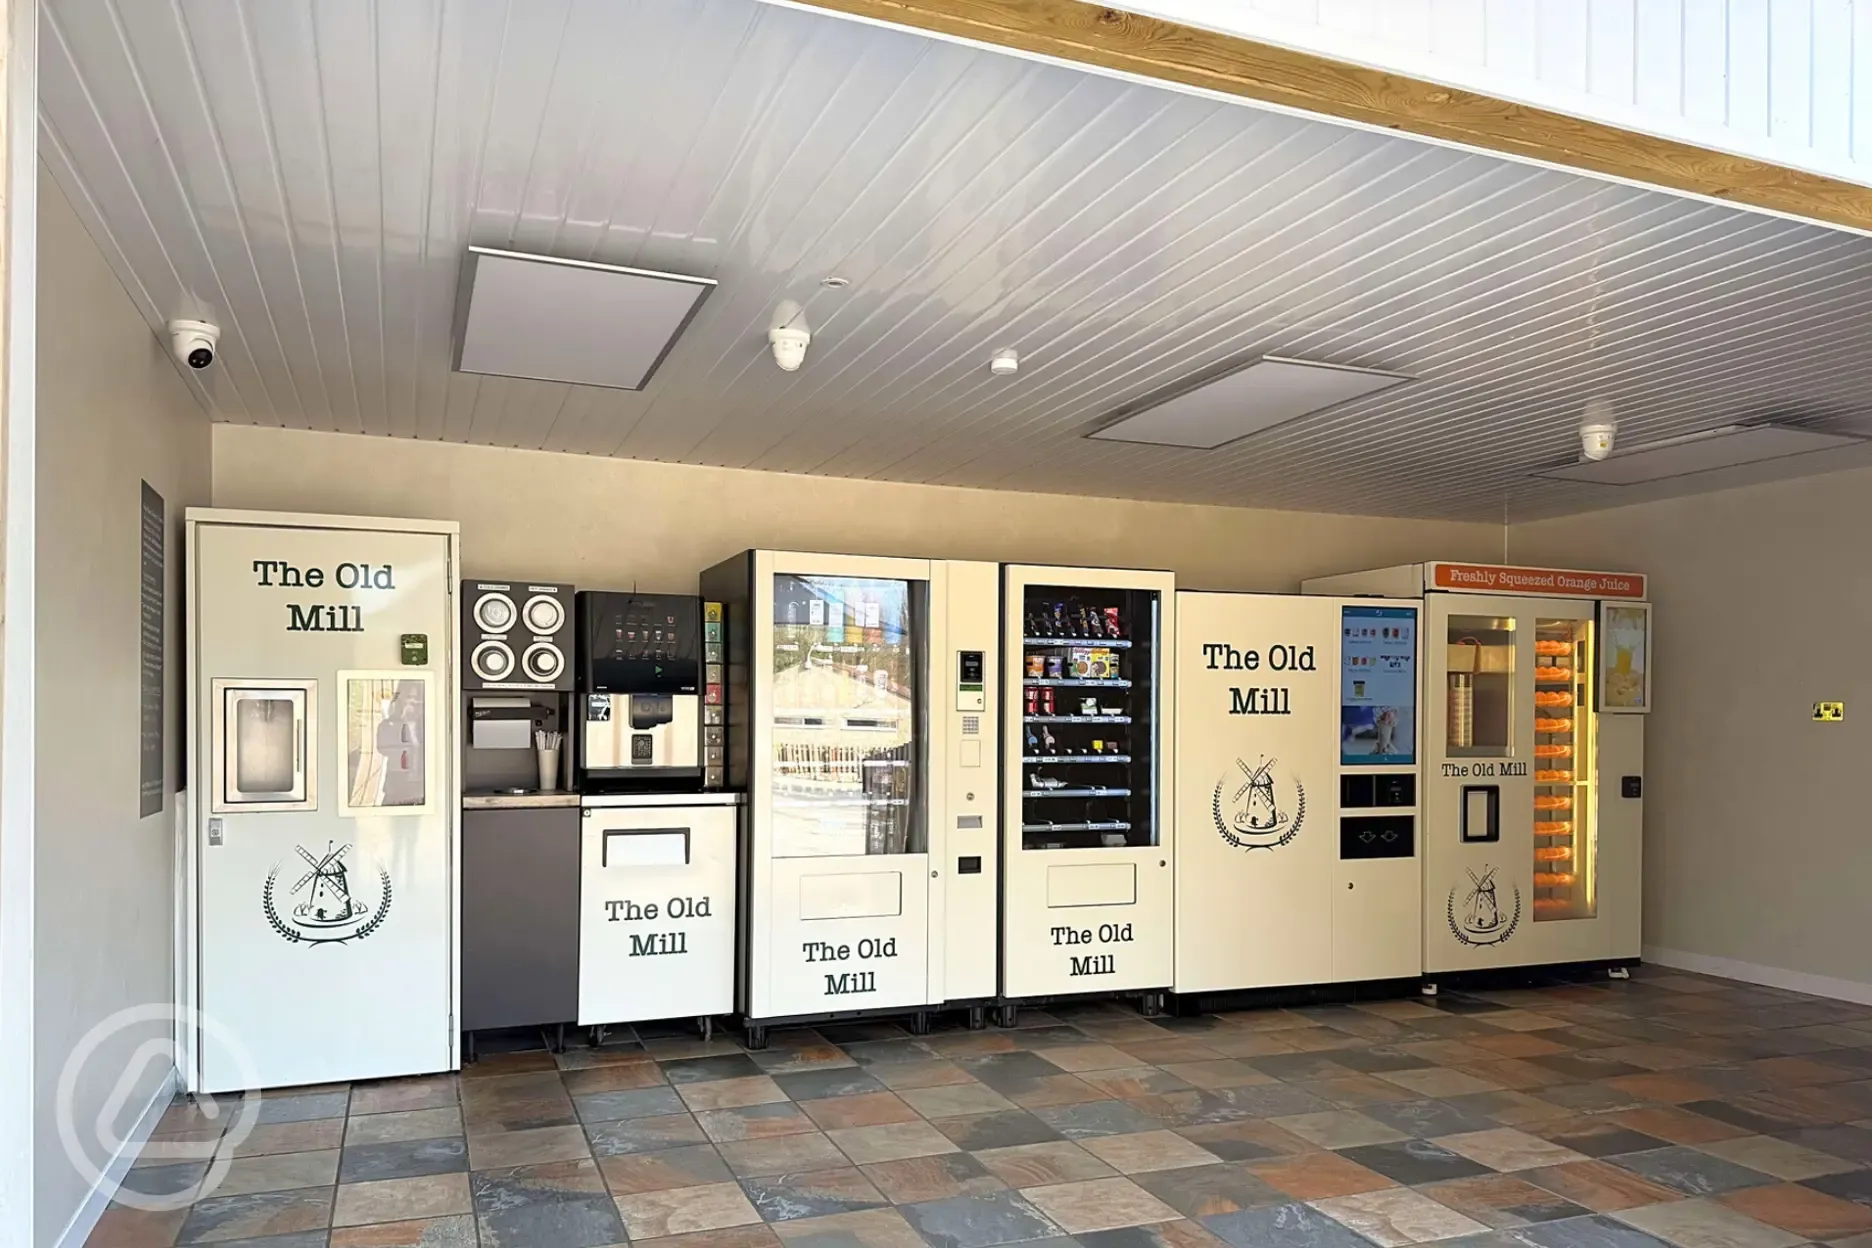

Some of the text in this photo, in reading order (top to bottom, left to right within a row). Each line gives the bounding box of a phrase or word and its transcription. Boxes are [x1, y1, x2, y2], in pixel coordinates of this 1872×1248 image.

[252, 560, 396, 590] The Old
[1450, 569, 1631, 591] Freshly Squeezed Orange Juice
[286, 603, 366, 632] Mill
[1202, 643, 1317, 672] The Old
[1228, 687, 1292, 715] Mill
[1441, 762, 1528, 777] The Old Mill
[604, 896, 712, 922] The Old
[628, 931, 689, 957] Mill
[1050, 922, 1135, 946] The Old
[802, 937, 898, 963] The Old
[1069, 954, 1116, 977] Mill
[823, 971, 877, 996] Mill
